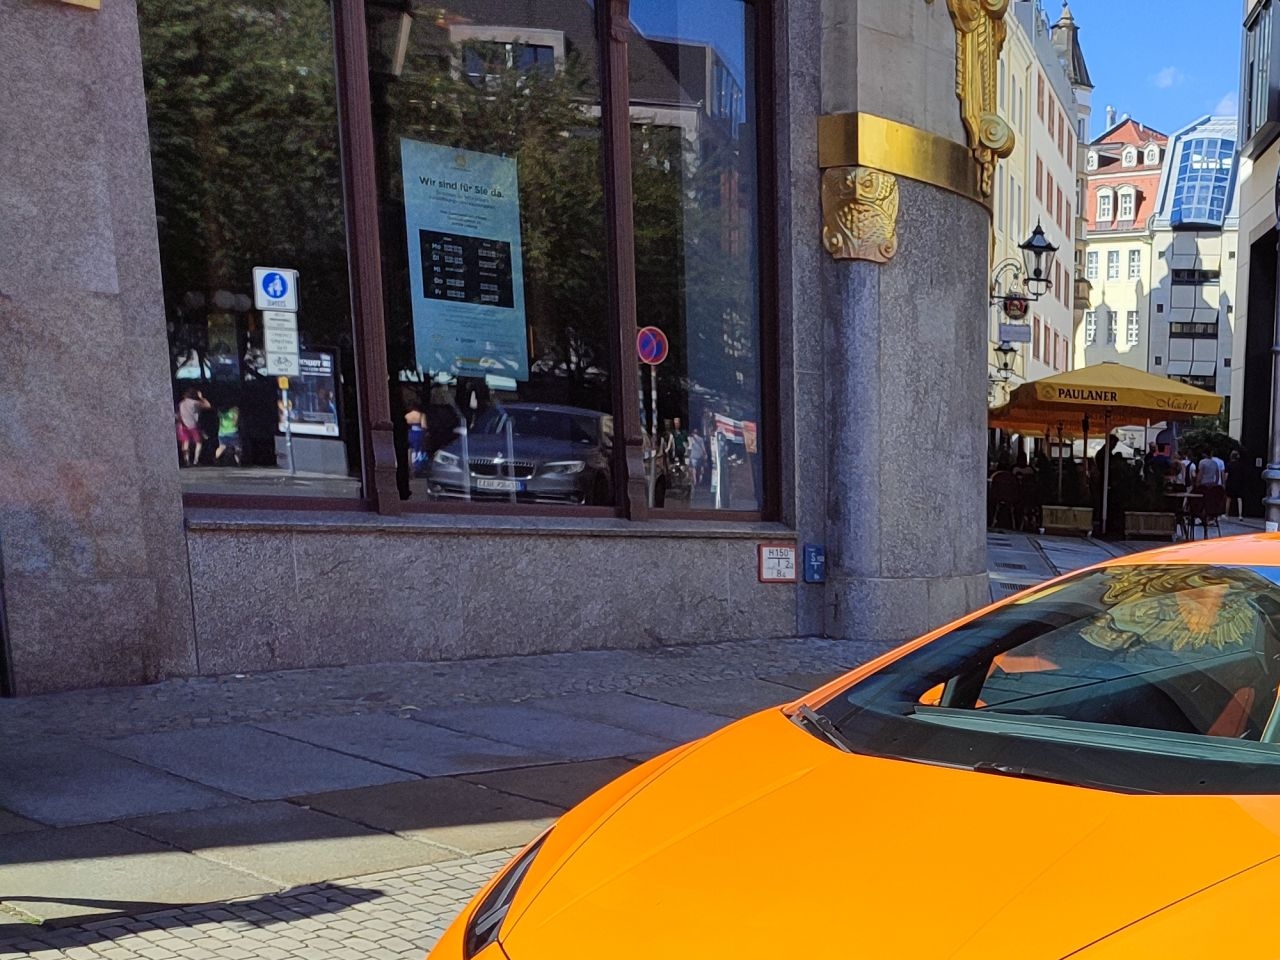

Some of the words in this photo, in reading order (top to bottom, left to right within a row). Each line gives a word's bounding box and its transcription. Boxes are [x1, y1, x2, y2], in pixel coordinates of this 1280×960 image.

[418, 176, 436, 187] Wir
[438, 181, 458, 190] sind
[460, 184, 473, 193] für
[474, 185, 488, 196] Sie
[491, 188, 505, 198] da.
[1058, 387, 1118, 402] PAULANER
[1155, 396, 1199, 411] Madrid
